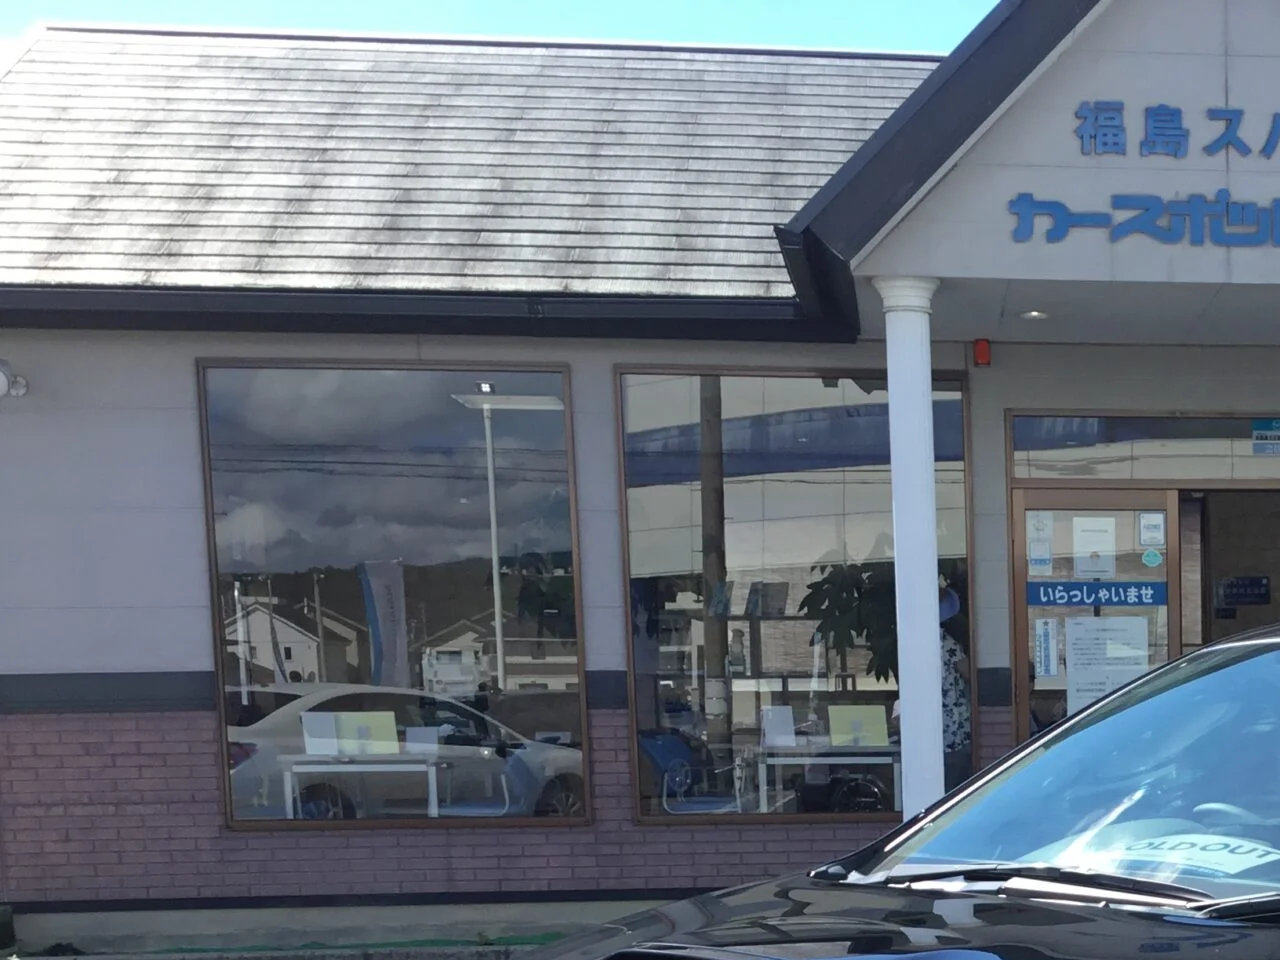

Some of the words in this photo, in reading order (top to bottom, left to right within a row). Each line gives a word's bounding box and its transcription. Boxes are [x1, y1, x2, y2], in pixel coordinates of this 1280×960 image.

[1039, 585, 1154, 604] いらっしゃいませ
